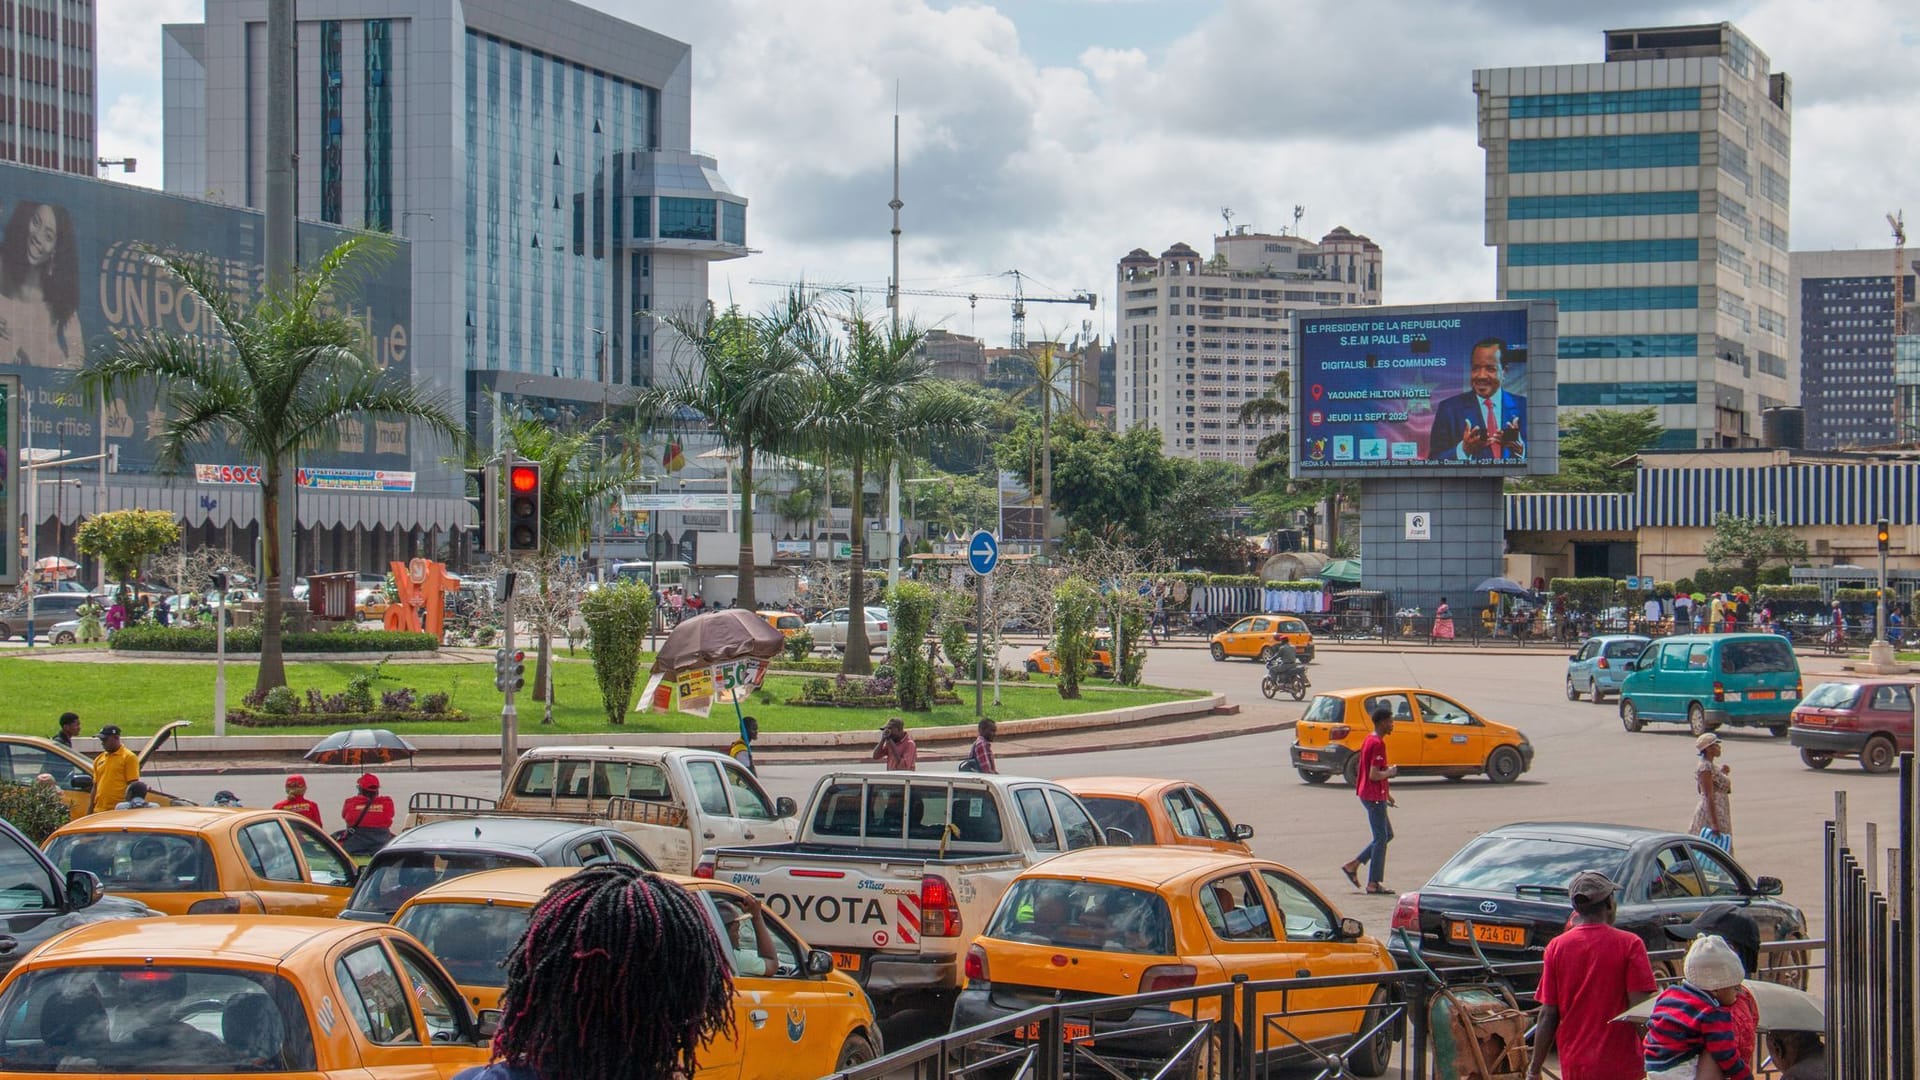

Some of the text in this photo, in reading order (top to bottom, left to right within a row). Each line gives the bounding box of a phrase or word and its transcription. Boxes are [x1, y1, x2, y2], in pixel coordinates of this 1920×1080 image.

[1264, 243, 1292, 253] Hilton
[1306, 325, 1317, 333] LE
[1319, 323, 1370, 333] PRESIDENT
[1371, 322, 1385, 331] DE
[1386, 321, 1400, 330] LA
[1371, 334, 1400, 345] PAUL
[1392, 357, 1447, 369] COMMUNES
[1369, 390, 1400, 399] HILTON
[1327, 411, 1408, 422] JEUDI 11 SEPT 2025
[380, 427, 402, 443] max
[1503, 929, 1518, 942] GV
[836, 954, 852, 968] JN
